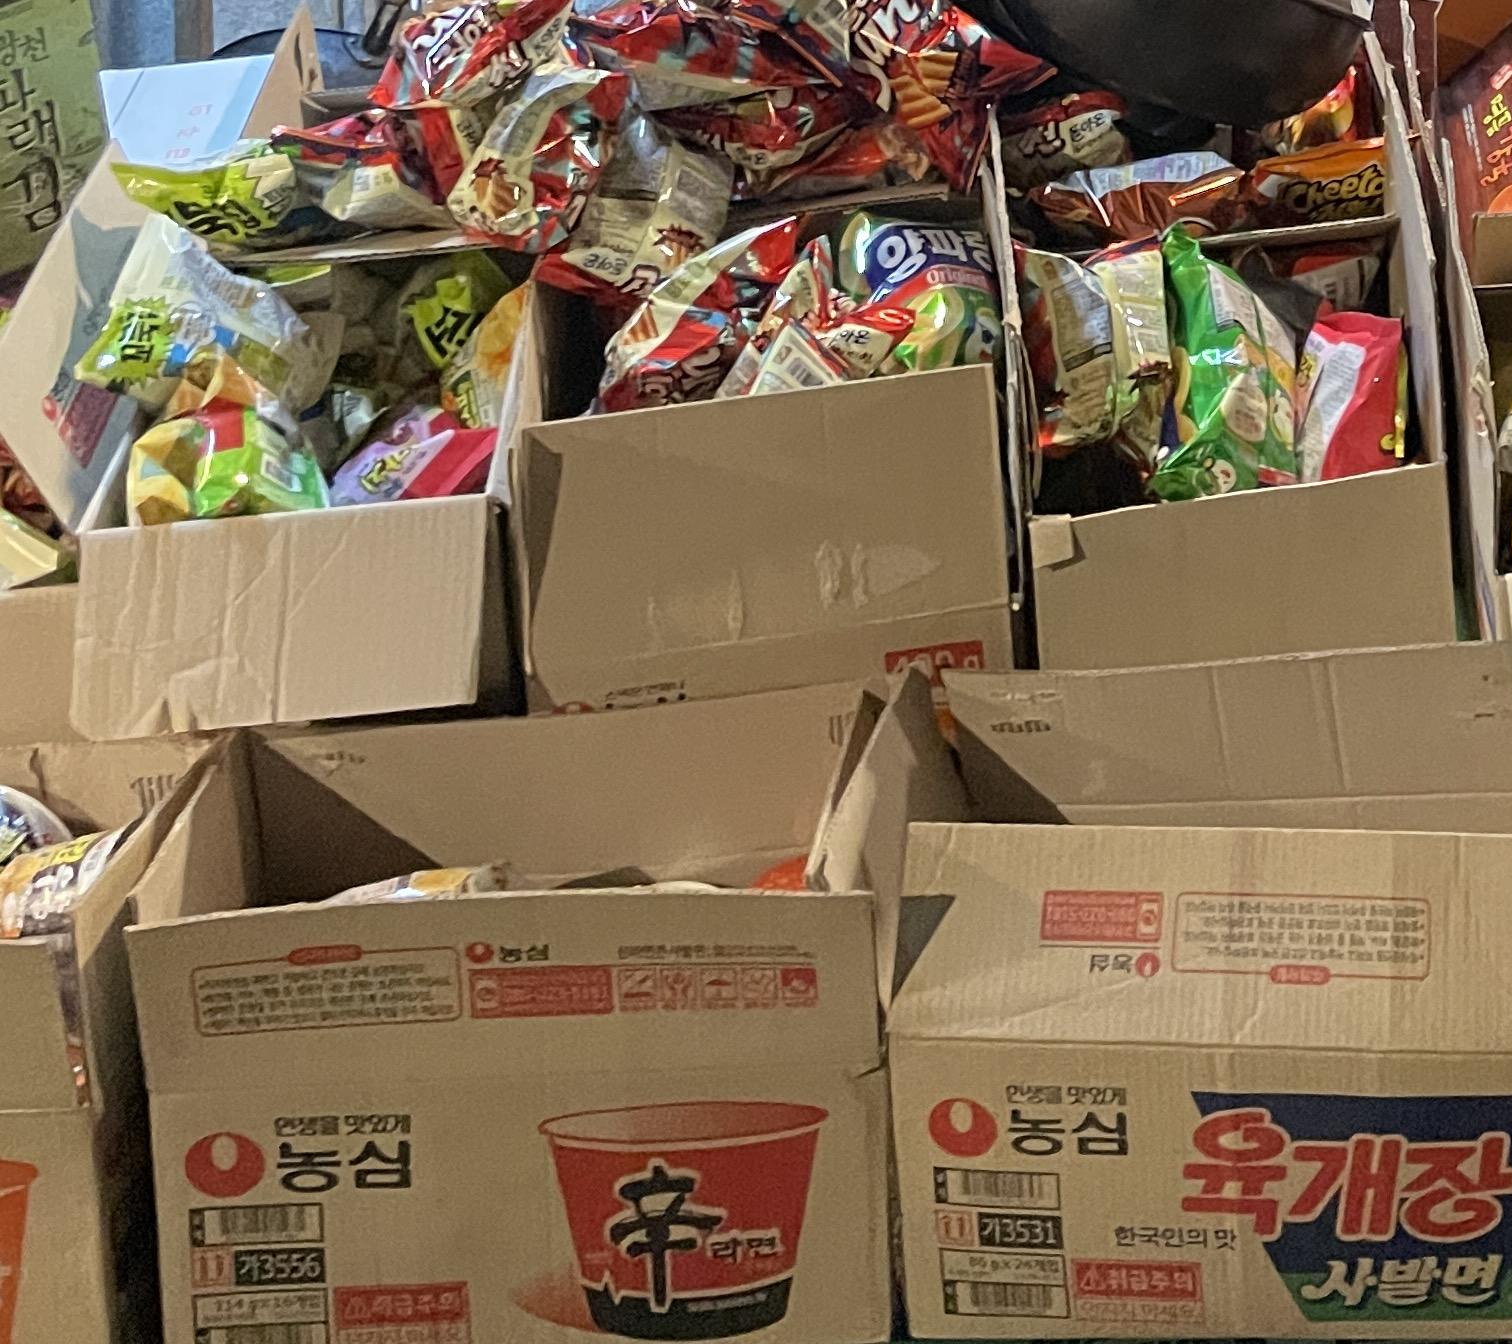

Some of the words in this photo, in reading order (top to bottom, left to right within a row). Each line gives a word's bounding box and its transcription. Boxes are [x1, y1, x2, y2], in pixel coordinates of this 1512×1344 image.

[1007, 1108, 1128, 1156] 농심
[276, 1139, 412, 1193] 농심
[608, 1164, 726, 1310] 辛
[708, 1230, 780, 1264] 라면
[1113, 1224, 1207, 1248] 한국인의
[1213, 1226, 1237, 1251] 맛
[1300, 1253, 1505, 1307] 사발면
